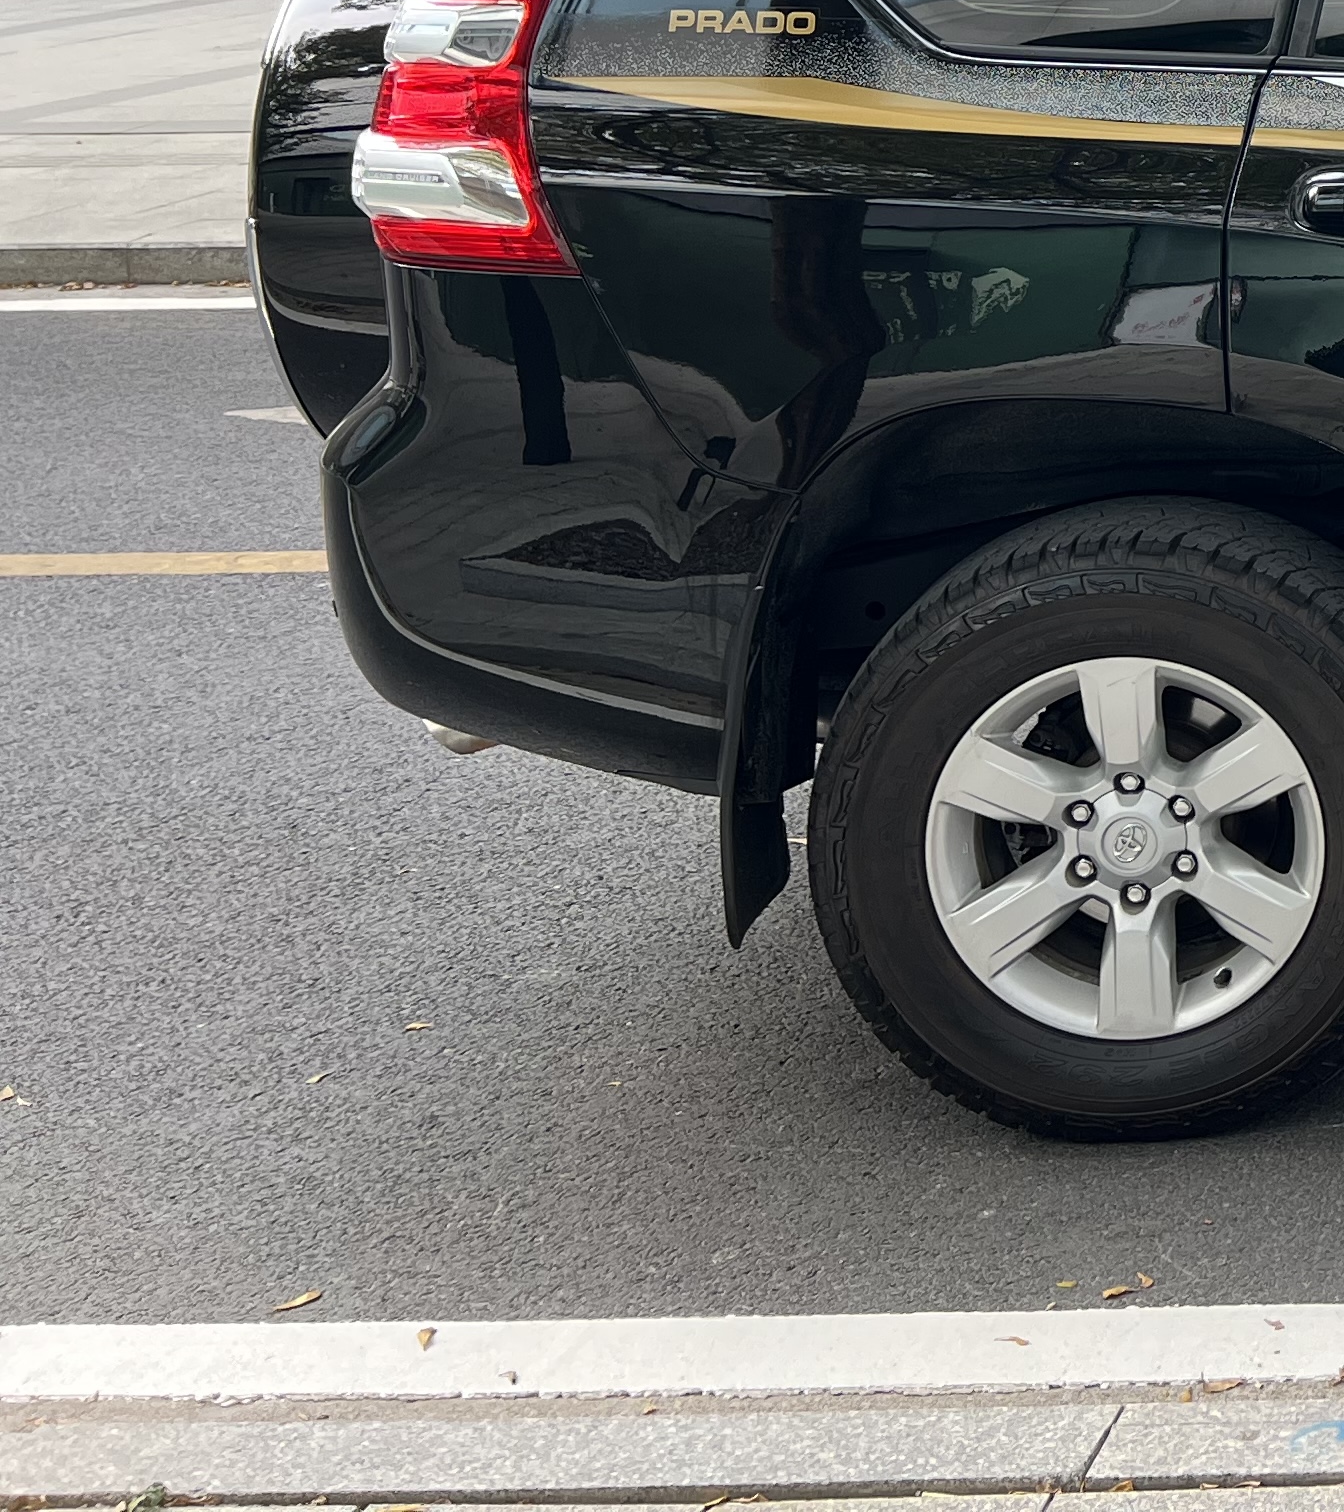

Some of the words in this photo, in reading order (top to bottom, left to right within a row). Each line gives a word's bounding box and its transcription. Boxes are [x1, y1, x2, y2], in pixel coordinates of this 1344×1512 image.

[668, 9, 817, 35] PRADO
[395, 173, 439, 183] CRUISER
[1022, 1044, 1149, 1091] 292
